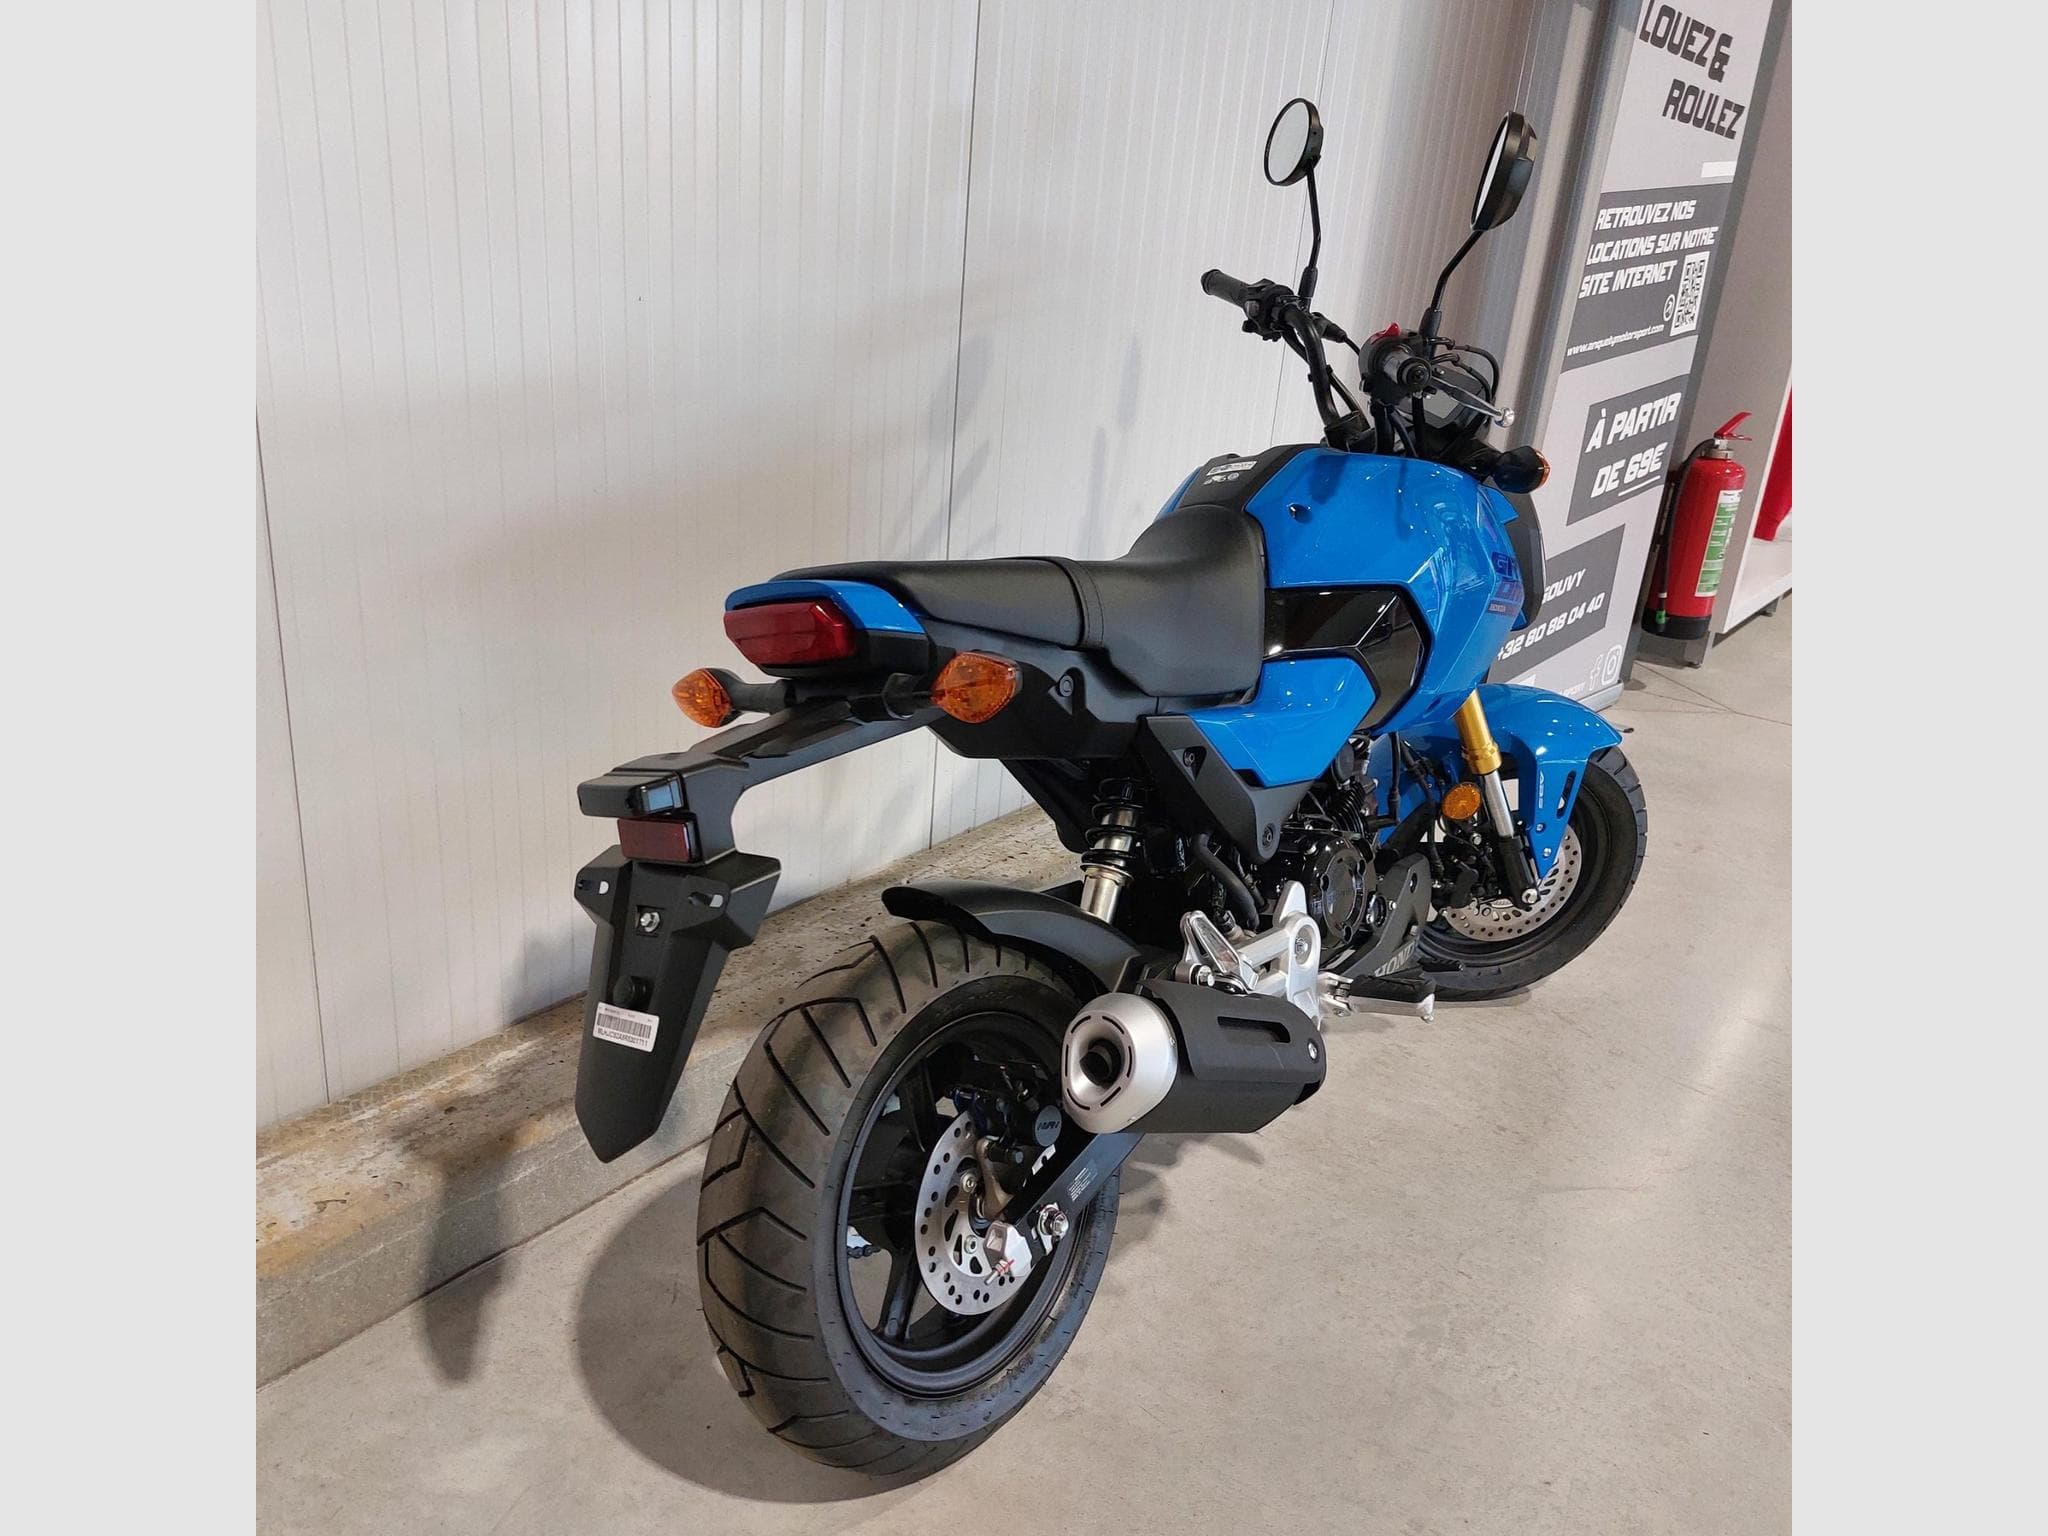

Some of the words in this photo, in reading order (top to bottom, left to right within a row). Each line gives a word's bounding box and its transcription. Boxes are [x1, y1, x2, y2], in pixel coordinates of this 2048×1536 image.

[1639, 0, 1716, 67] LOUEZ
[1708, 33, 1733, 82] &
[1662, 78, 1745, 139] ROULEZ
[1595, 202, 1673, 231] RETROUVEZ
[1670, 199, 1697, 221] NOS
[1586, 235, 1656, 266] LOCATIONS
[1654, 231, 1682, 254] SUR
[1680, 226, 1719, 250] NOTRE
[1578, 271, 1614, 299] SITE
[1612, 259, 1678, 292] INTERNET
[1584, 407, 1607, 453] À
[1606, 392, 1682, 446] PARTIR
[1590, 458, 1627, 499] DE
[1524, 622, 1547, 648] 80
[1546, 611, 1568, 637] 88
[1566, 601, 1587, 626] 04
[1585, 592, 1606, 614] 40
